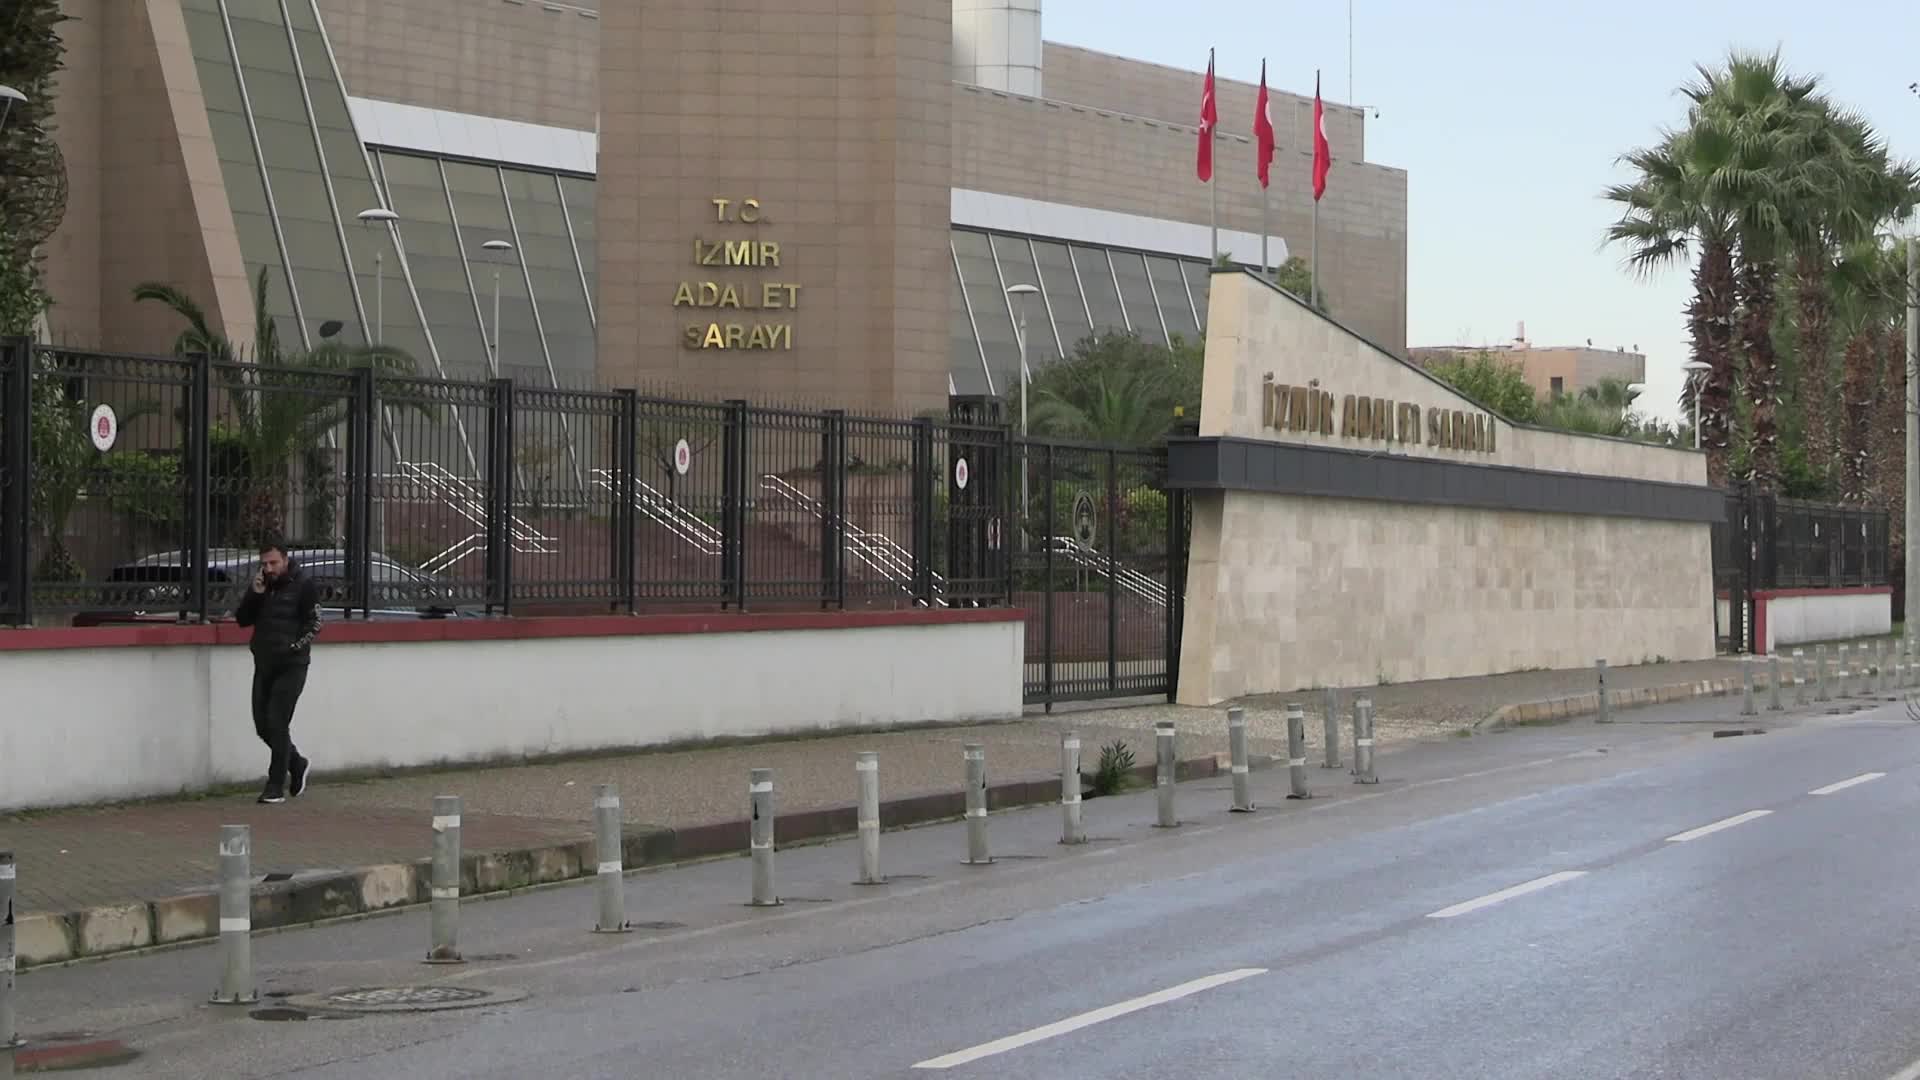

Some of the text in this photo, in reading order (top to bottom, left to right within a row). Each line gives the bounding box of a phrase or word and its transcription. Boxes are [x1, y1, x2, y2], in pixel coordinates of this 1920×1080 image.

[673, 281, 801, 309] ADALET
[685, 323, 792, 350] SARAYI
[1341, 394, 1421, 445] ADALET
